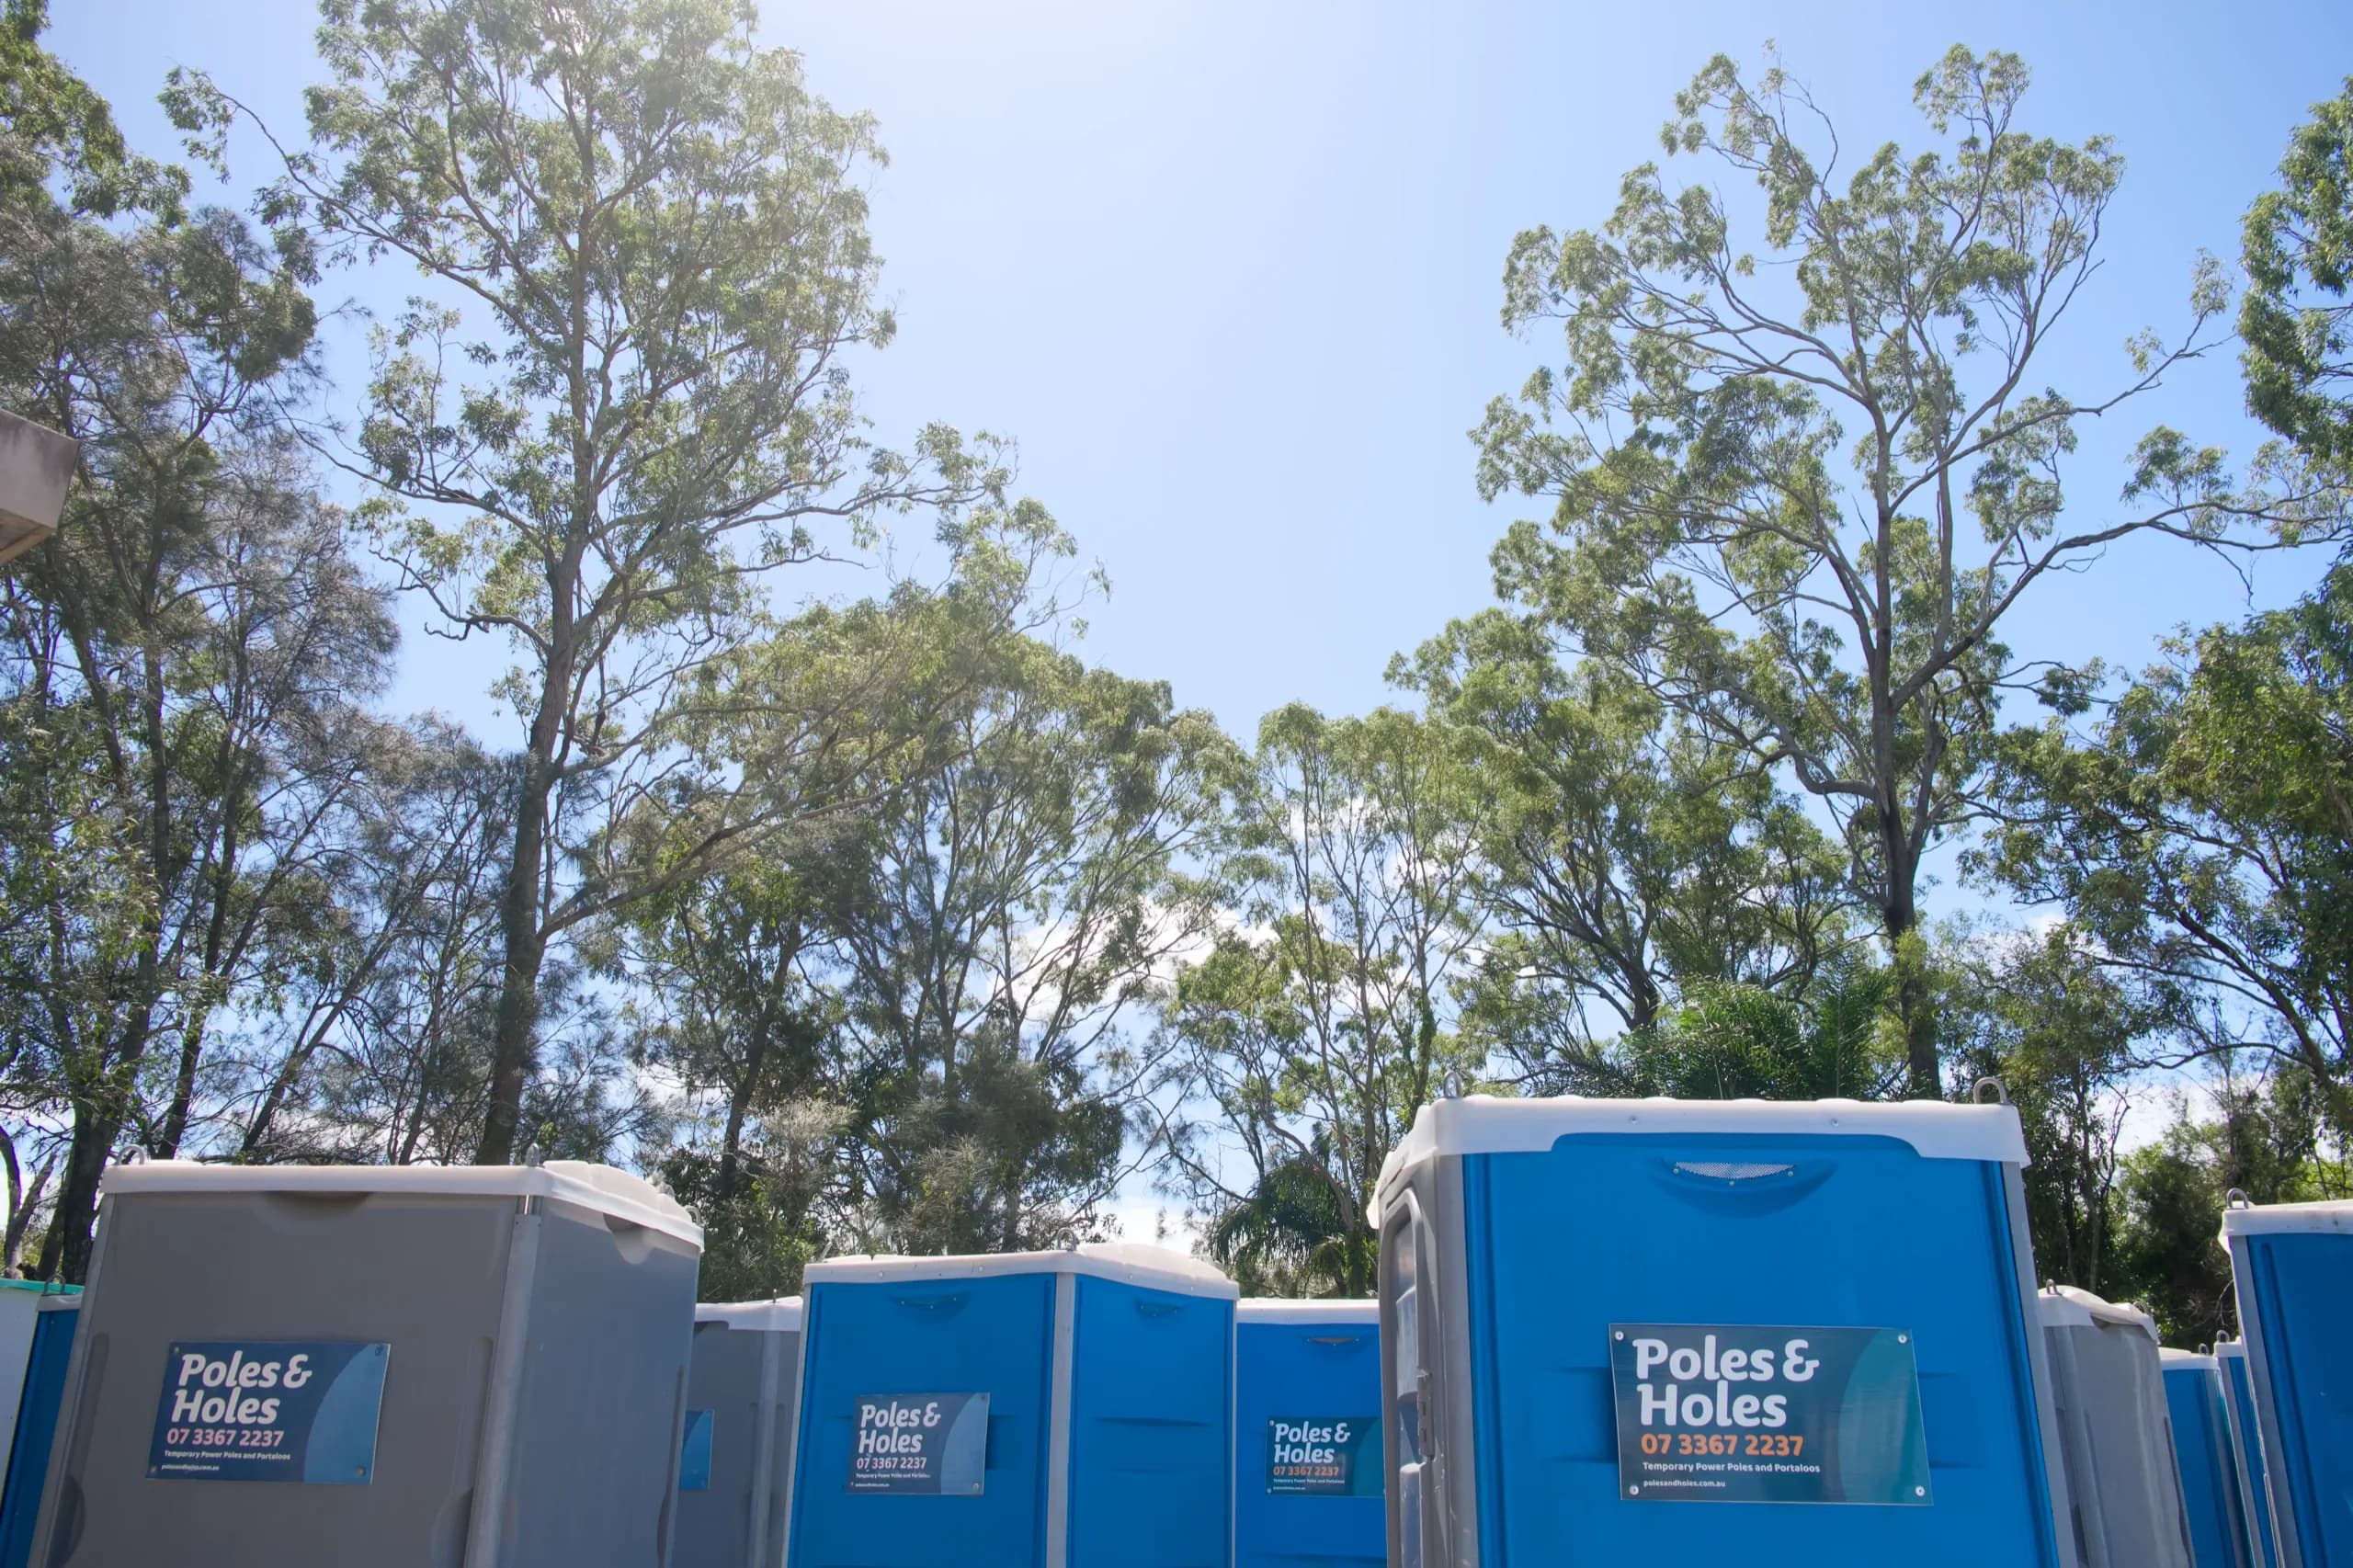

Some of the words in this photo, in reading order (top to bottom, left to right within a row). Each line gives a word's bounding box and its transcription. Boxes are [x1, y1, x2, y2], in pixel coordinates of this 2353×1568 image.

[177, 1350, 281, 1388] Poles
[283, 1354, 313, 1388] &
[1632, 1335, 1775, 1381] Poles
[1782, 1339, 1820, 1382] &
[171, 1387, 280, 1425] Holes
[860, 1401, 921, 1427] Poles
[923, 1403, 941, 1427] &
[1636, 1380, 1788, 1427] Holes
[166, 1428, 189, 1445] 07
[192, 1429, 236, 1447] 3367
[239, 1430, 284, 1448] 2237
[858, 1426, 923, 1454] Holes
[1274, 1421, 1332, 1443] Poles
[1334, 1423, 1351, 1443] &
[165, 1449, 199, 1460] Temporary
[200, 1450, 222, 1459] Power
[223, 1450, 242, 1460] Poles
[243, 1451, 256, 1460] and
[256, 1452, 291, 1460] Portaloos
[1274, 1441, 1335, 1463] Holes
[1641, 1433, 1672, 1455] 07
[1677, 1434, 1738, 1456] 3367
[1745, 1435, 1804, 1457] 2237
[857, 1458, 870, 1470] 07
[871, 1457, 898, 1470] 3367
[900, 1457, 927, 1470] 2237
[1273, 1466, 1286, 1476] 07
[1288, 1466, 1313, 1476] 3367
[1314, 1466, 1339, 1477] 2237
[1643, 1461, 1694, 1473] Temporary
[1696, 1462, 1725, 1472] Power
[1727, 1462, 1754, 1472] Poles
[1755, 1462, 1773, 1472] and
[1774, 1463, 1821, 1473] Portaloos
[1643, 1479, 1726, 1488] polesandholes.com.au
